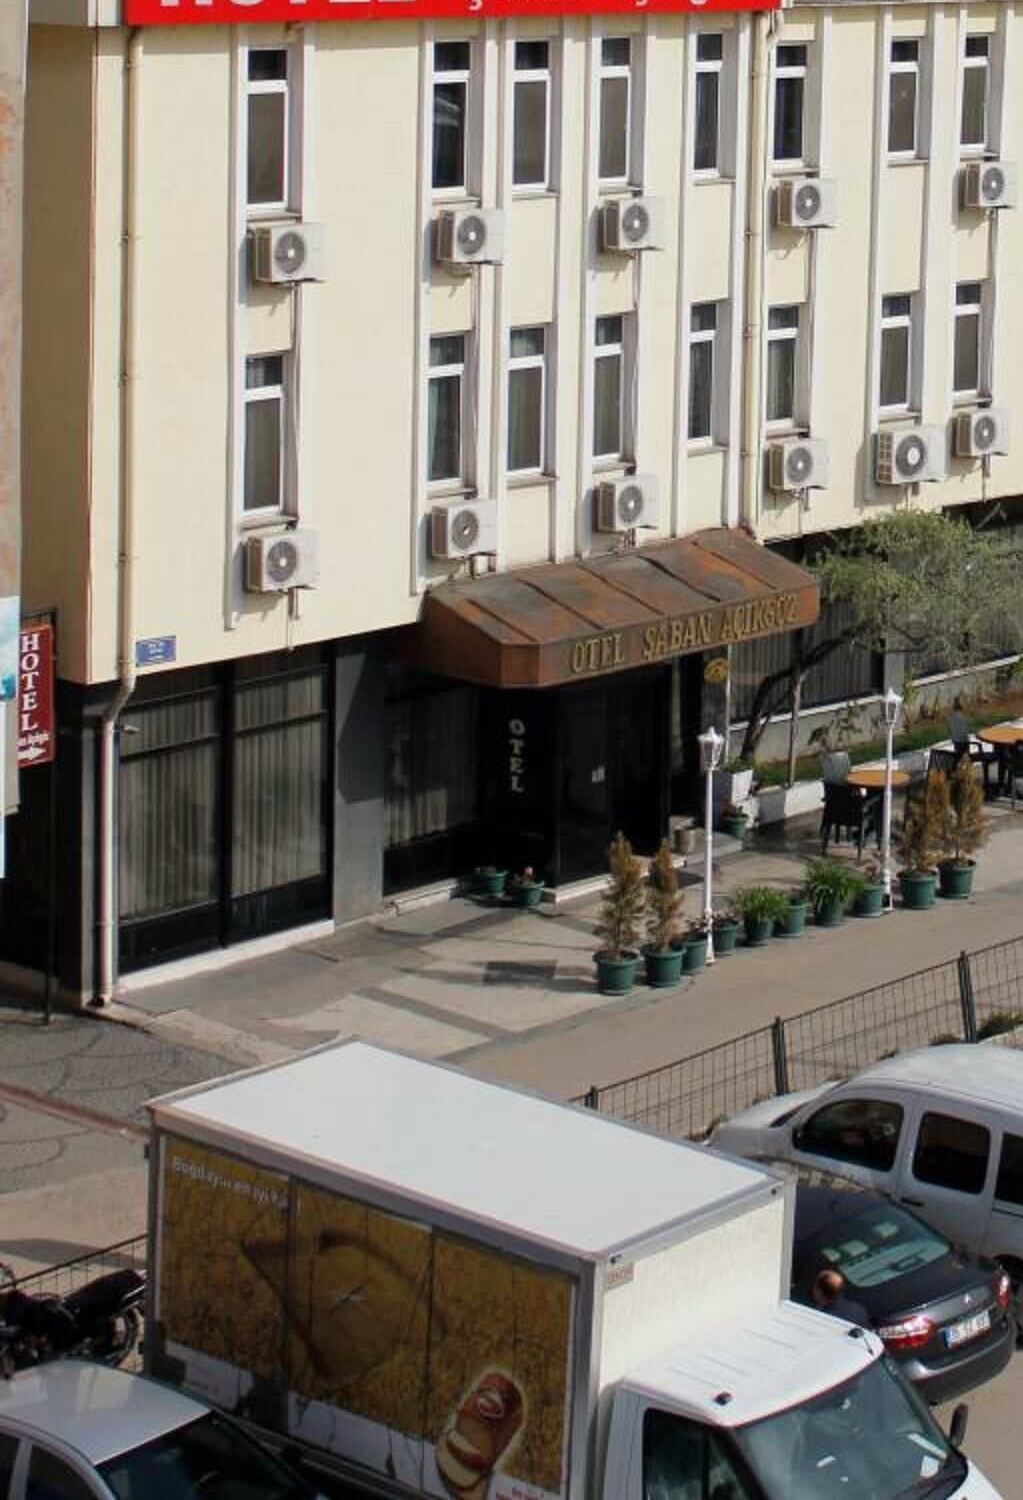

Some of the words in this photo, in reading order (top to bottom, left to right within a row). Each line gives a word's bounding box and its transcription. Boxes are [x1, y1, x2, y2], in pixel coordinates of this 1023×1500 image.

[21, 634, 39, 731] HOTEL
[572, 632, 625, 673] OTEL
[508, 718, 525, 793] OTEL
